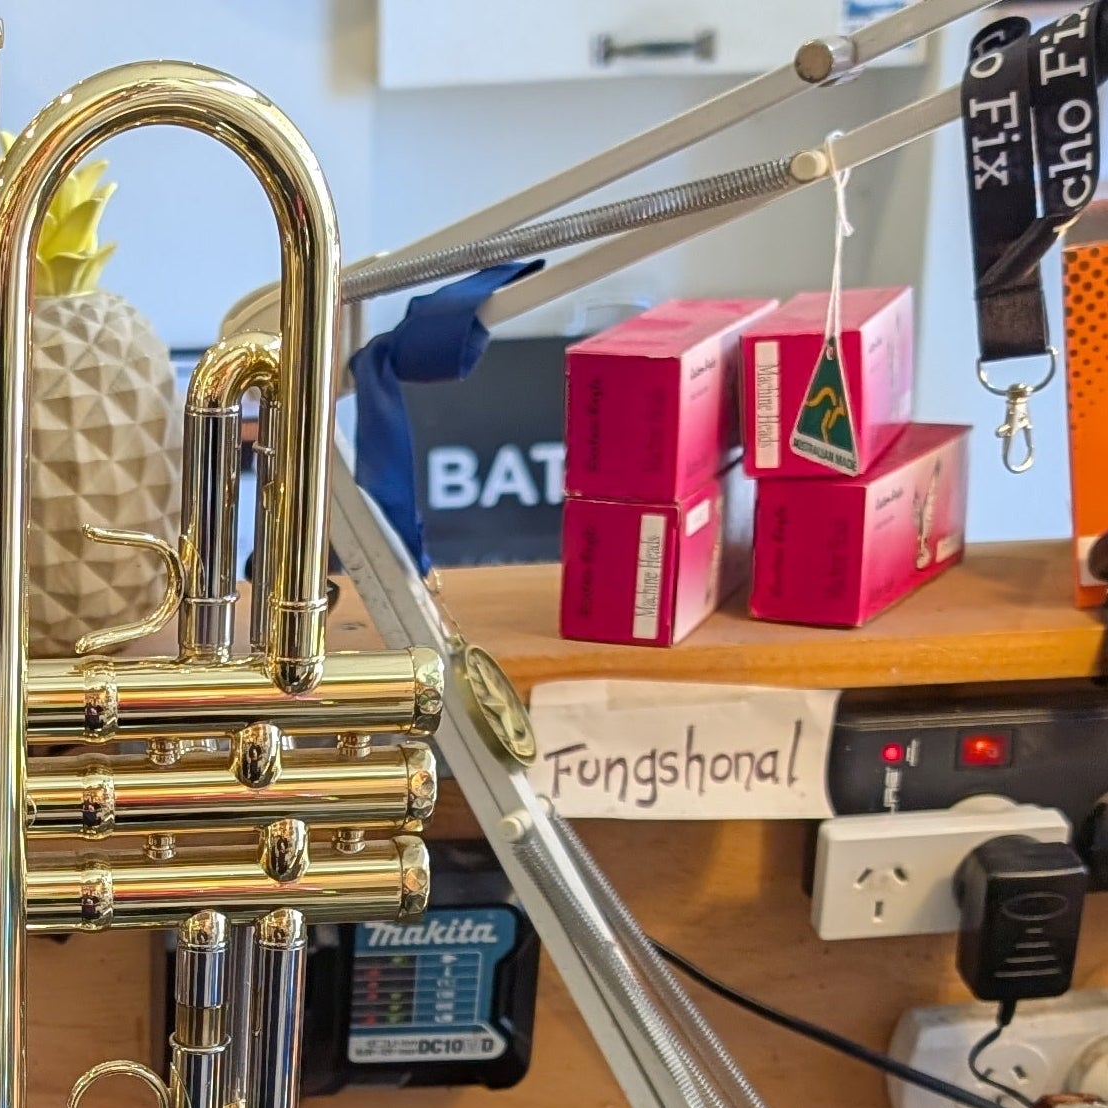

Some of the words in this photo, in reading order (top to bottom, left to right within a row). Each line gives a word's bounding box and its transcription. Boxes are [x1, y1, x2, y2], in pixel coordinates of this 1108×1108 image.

[969, 91, 1021, 190] Fix
[1048, 98, 1092, 212] cho
[756, 363, 780, 412] Machine
[756, 413, 780, 450] Heads
[427, 441, 567, 511] BAT
[642, 534, 661, 568] Heads
[636, 569, 661, 618] Machine
[544, 718, 803, 808] Fungshonal
